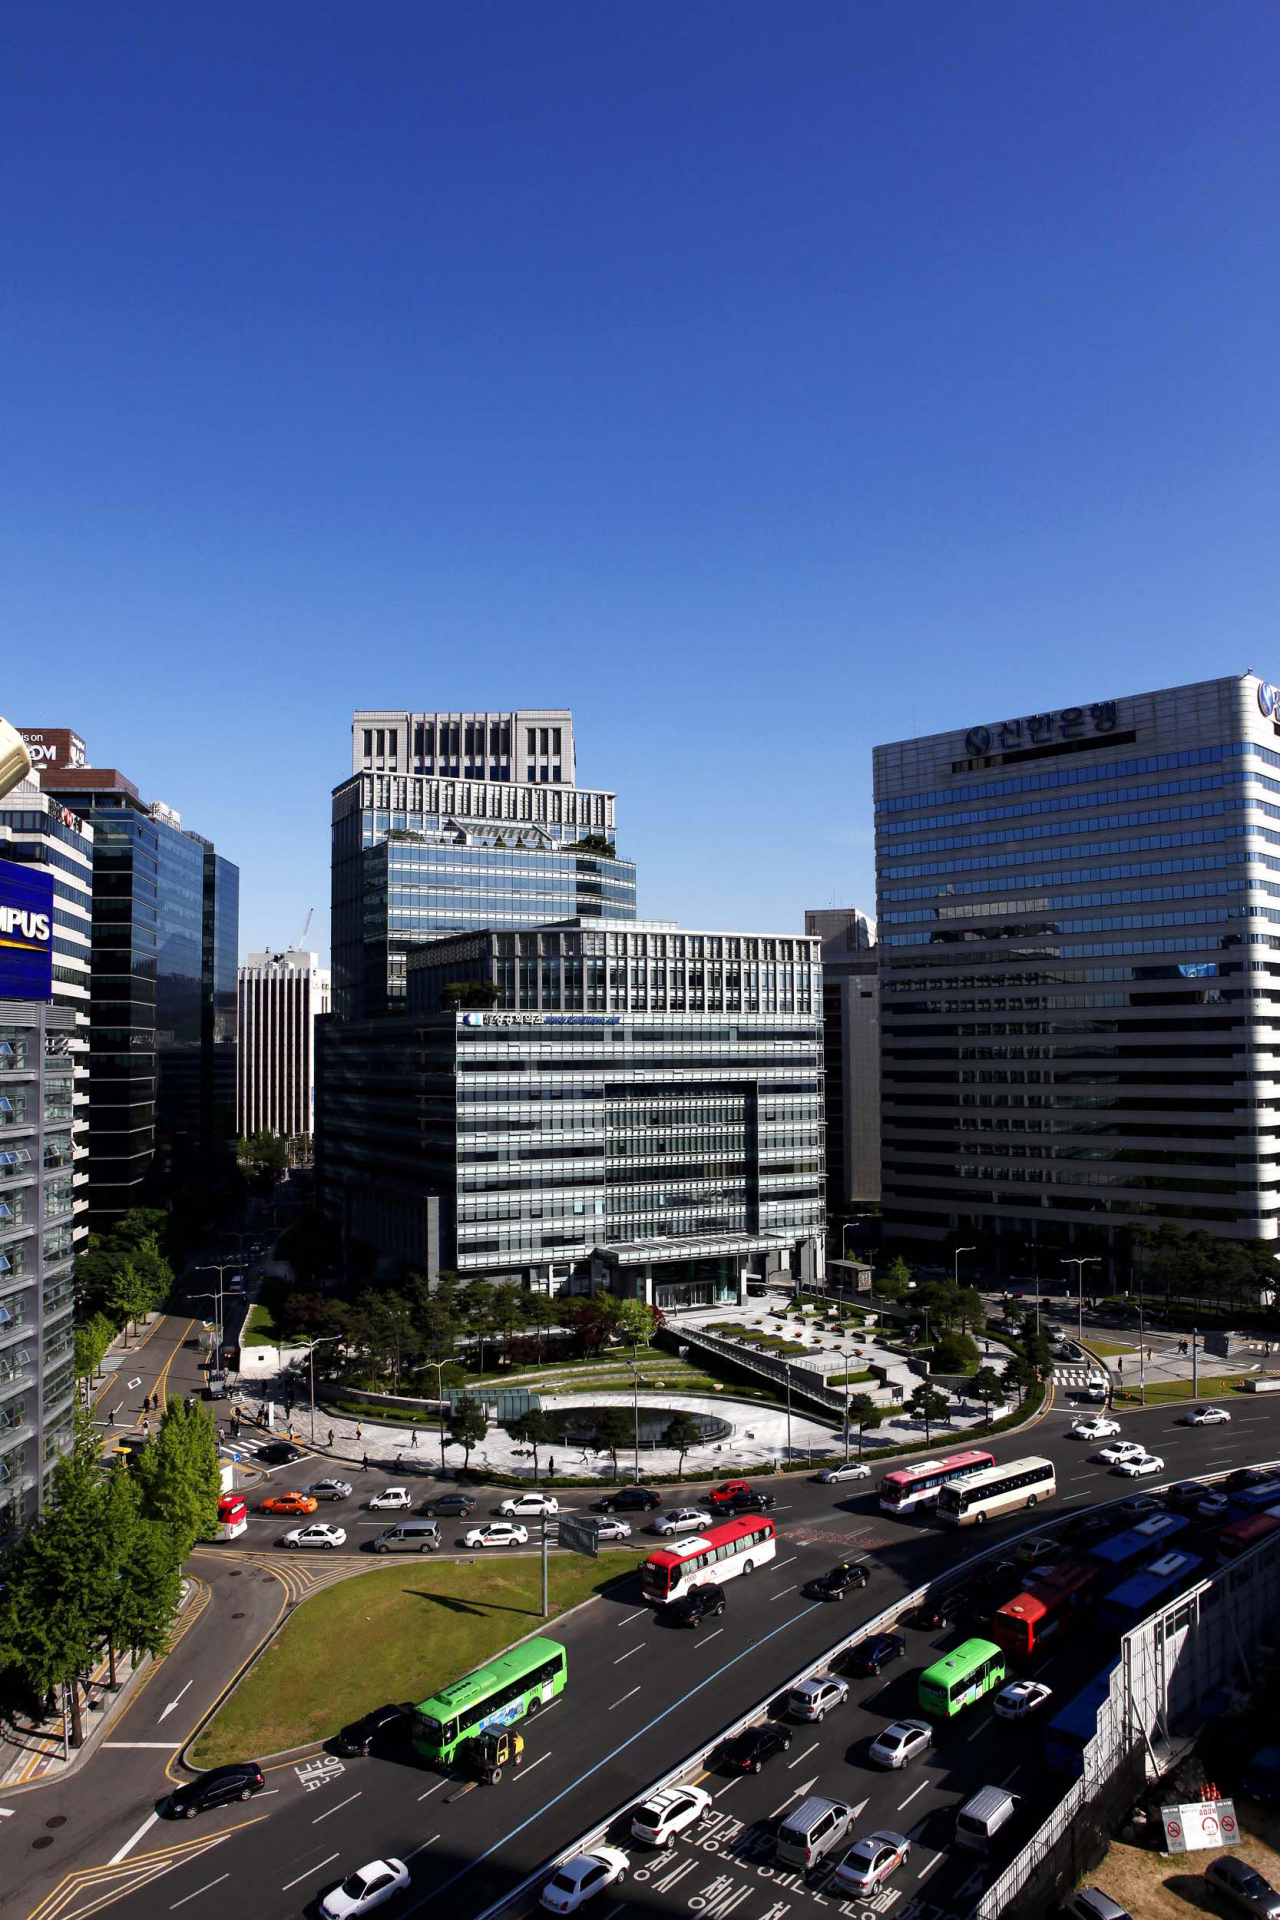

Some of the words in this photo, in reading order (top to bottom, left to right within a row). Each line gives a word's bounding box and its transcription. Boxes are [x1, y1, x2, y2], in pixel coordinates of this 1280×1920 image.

[997, 700, 1118, 748] 신한은행
[31, 734, 43, 742] on
[684, 1574, 697, 1584] 1000
